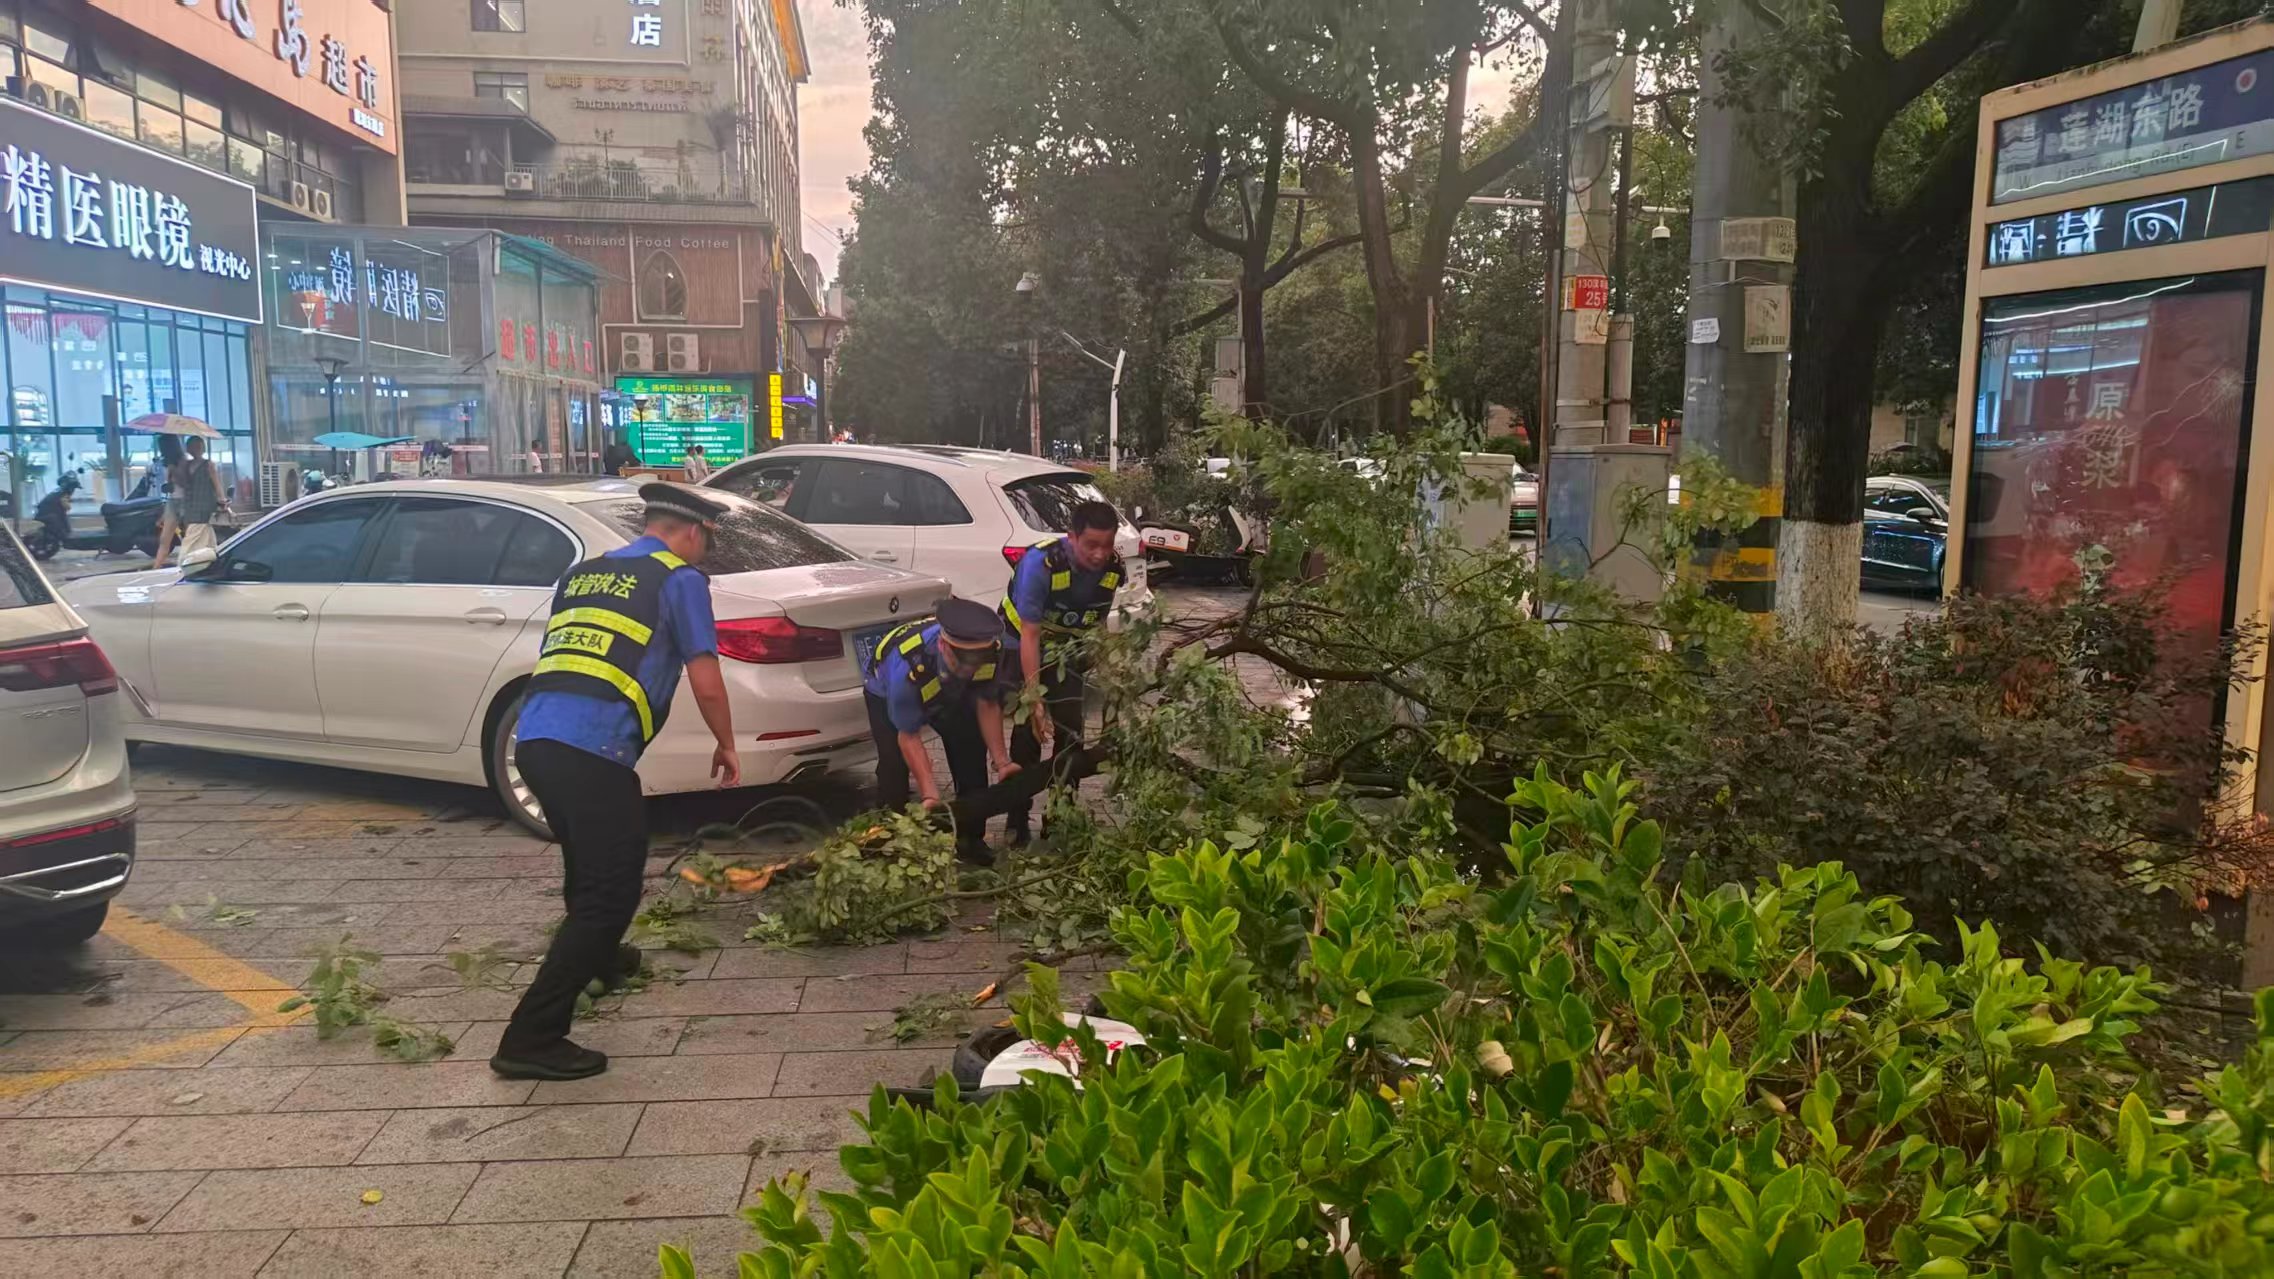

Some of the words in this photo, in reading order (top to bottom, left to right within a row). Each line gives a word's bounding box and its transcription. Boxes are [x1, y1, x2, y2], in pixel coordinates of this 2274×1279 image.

[2, 144, 195, 271] 精医眼镜
[635, 236, 671, 249] Food
[199, 244, 252, 281] 视光中心
[564, 573, 638, 600] 城管执法
